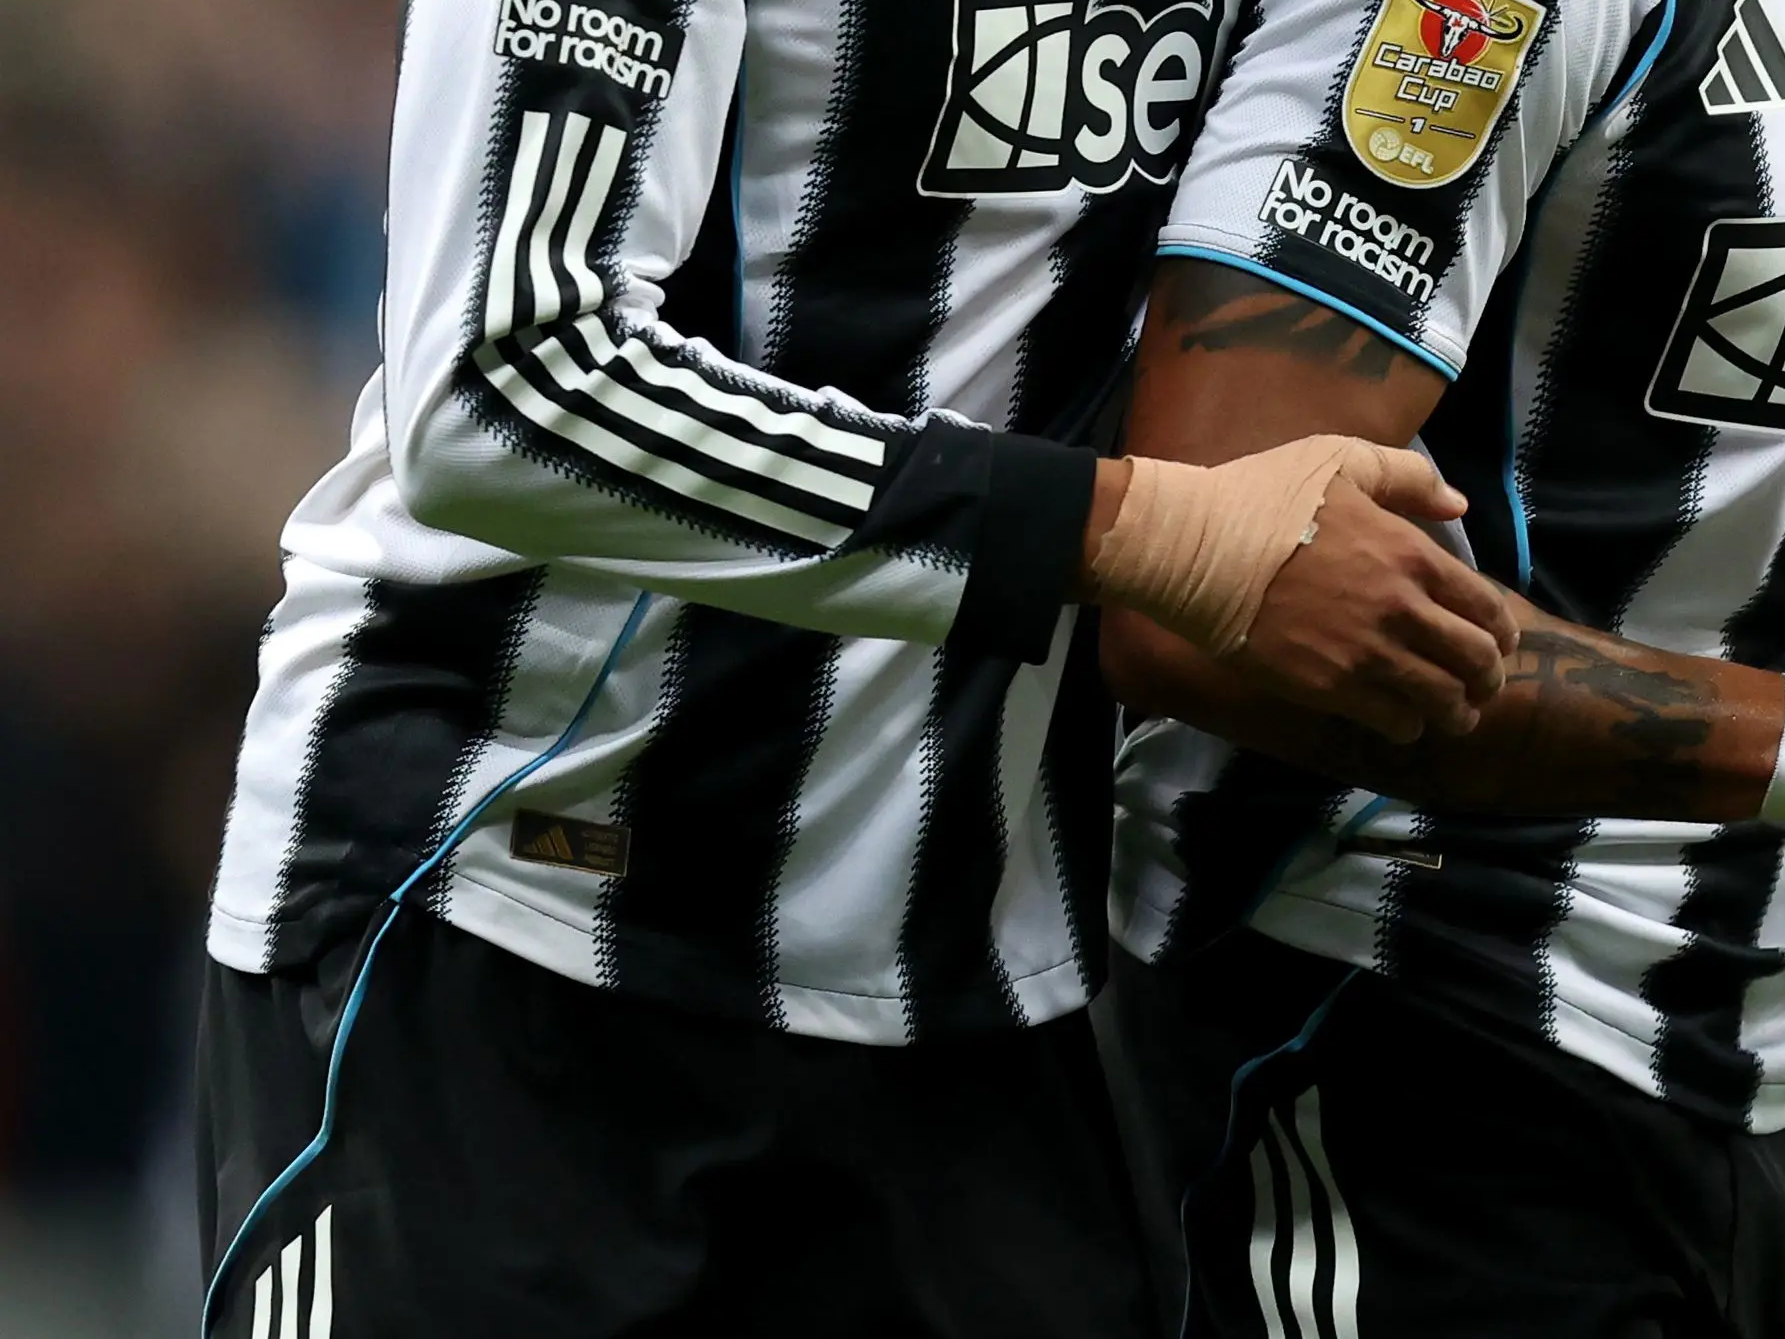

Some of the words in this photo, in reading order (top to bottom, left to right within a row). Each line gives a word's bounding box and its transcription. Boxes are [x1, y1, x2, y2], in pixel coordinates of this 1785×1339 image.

[495, 20, 556, 62] for
[559, 40, 671, 99] racism
[568, 3, 663, 61] room
[1373, 44, 1503, 92] Carabao
[1396, 77, 1461, 113] Cup
[1398, 142, 1434, 174] EFL
[1271, 161, 1333, 209] No
[1333, 195, 1434, 264] room
[1260, 191, 1322, 237] for
[1319, 224, 1434, 302] racism
